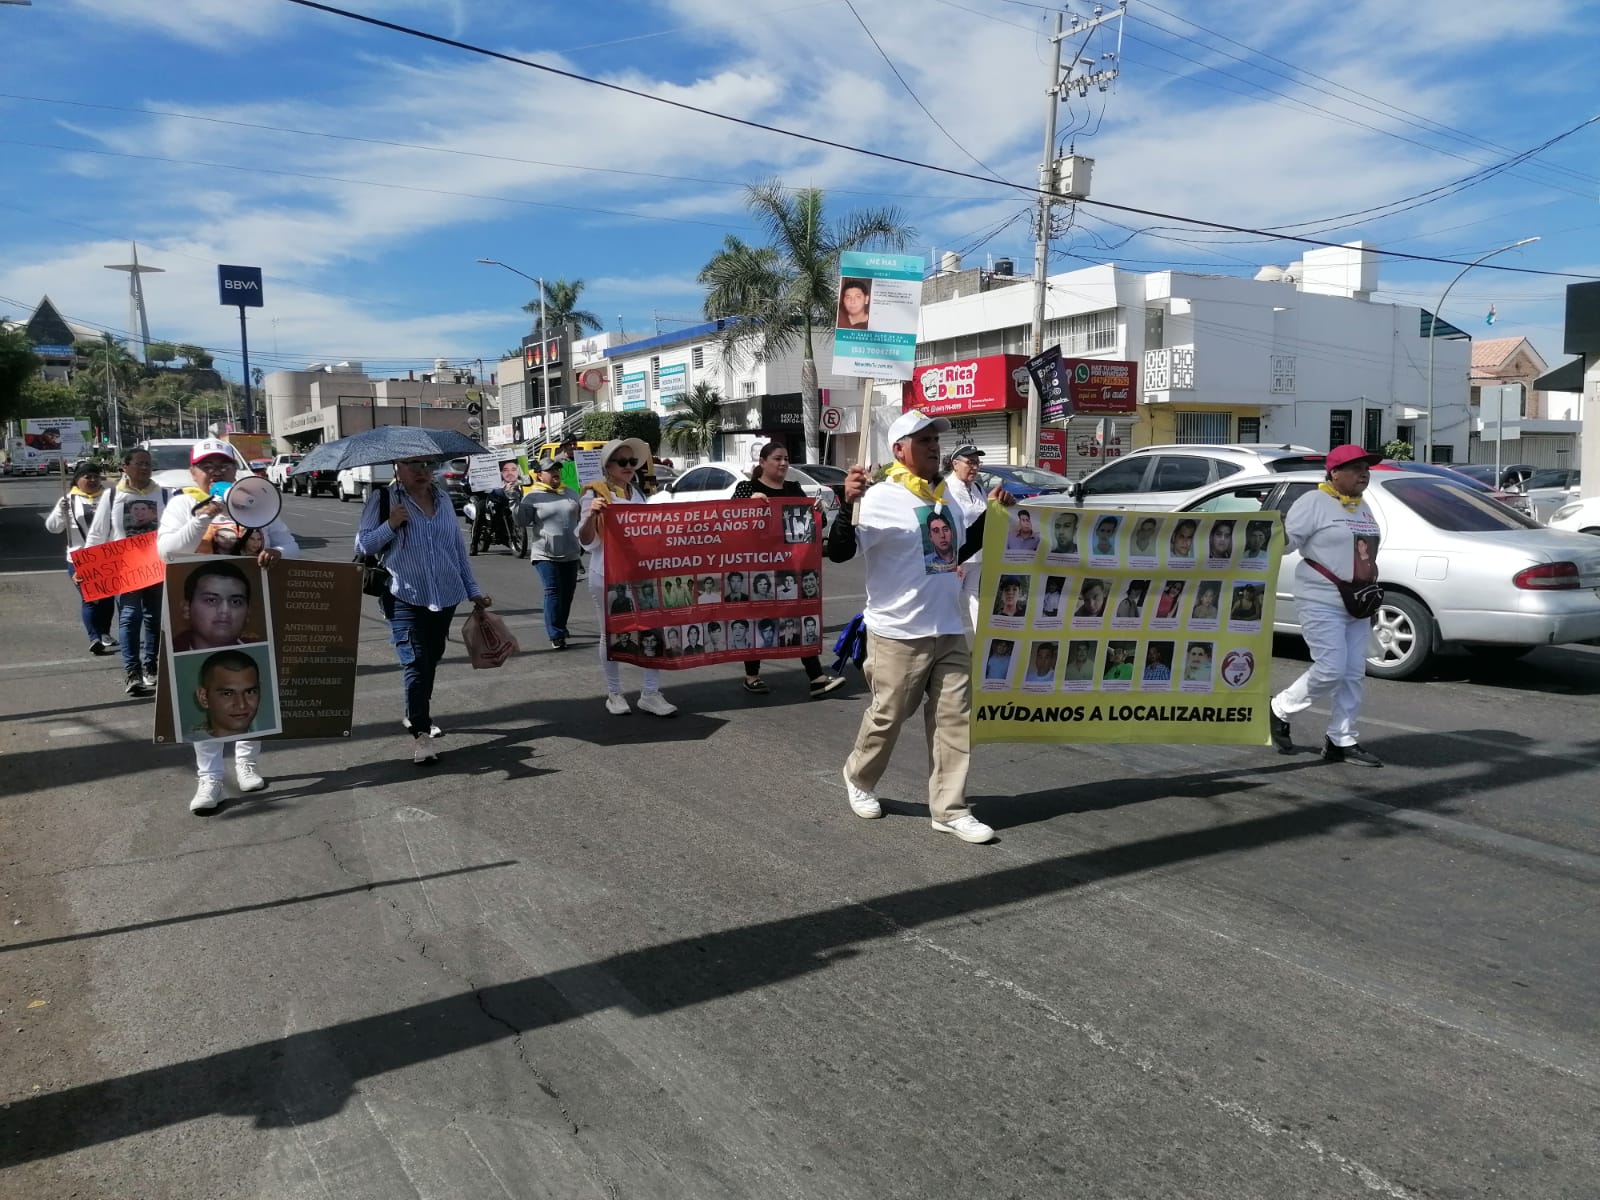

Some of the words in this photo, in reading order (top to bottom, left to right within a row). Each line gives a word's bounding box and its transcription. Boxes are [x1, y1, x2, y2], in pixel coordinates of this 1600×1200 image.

[224, 280, 258, 290] BBVA
[946, 368, 973, 382] Rica
[616, 508, 680, 524] VÍCTIMAS
[684, 510, 700, 521] DE
[704, 509, 718, 520] LA
[722, 507, 772, 520] GUERRA
[624, 526, 662, 538] SUCIA
[666, 524, 684, 534] DE
[686, 523, 710, 533] LOS
[713, 520, 749, 532] AÑOS
[752, 520, 766, 530] 70
[666, 534, 722, 546] SINALOA
[706, 554, 716, 566] Y
[82, 560, 130, 581] HASTA
[976, 702, 1084, 722] AYÚDANOS
[1089, 706, 1103, 720] A
[1109, 705, 1252, 722] LOCALIZARLES!
